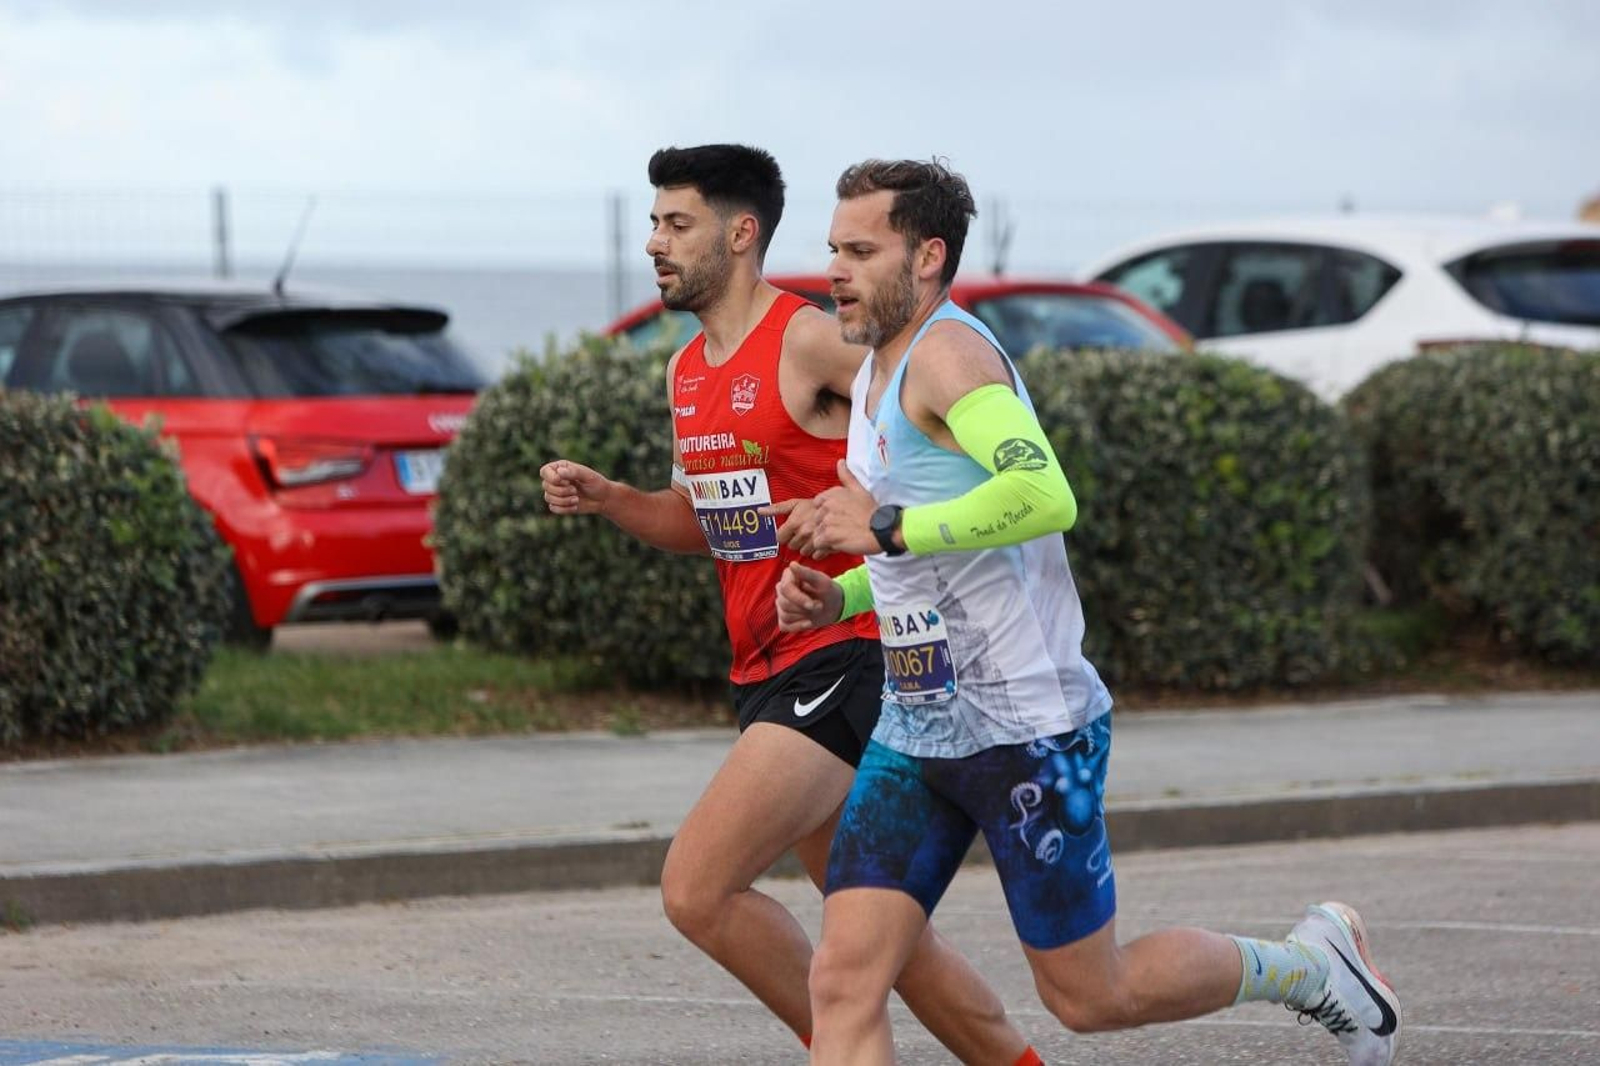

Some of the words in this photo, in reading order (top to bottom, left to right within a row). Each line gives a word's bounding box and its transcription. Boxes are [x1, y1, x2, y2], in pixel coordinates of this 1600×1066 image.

[680, 433, 736, 454] OUTUREIRA
[720, 446, 769, 467] natural
[691, 476, 757, 499] MINIBAY
[707, 509, 759, 536] 11449
[880, 609, 936, 637] NIBAY
[889, 646, 934, 676] 0067
